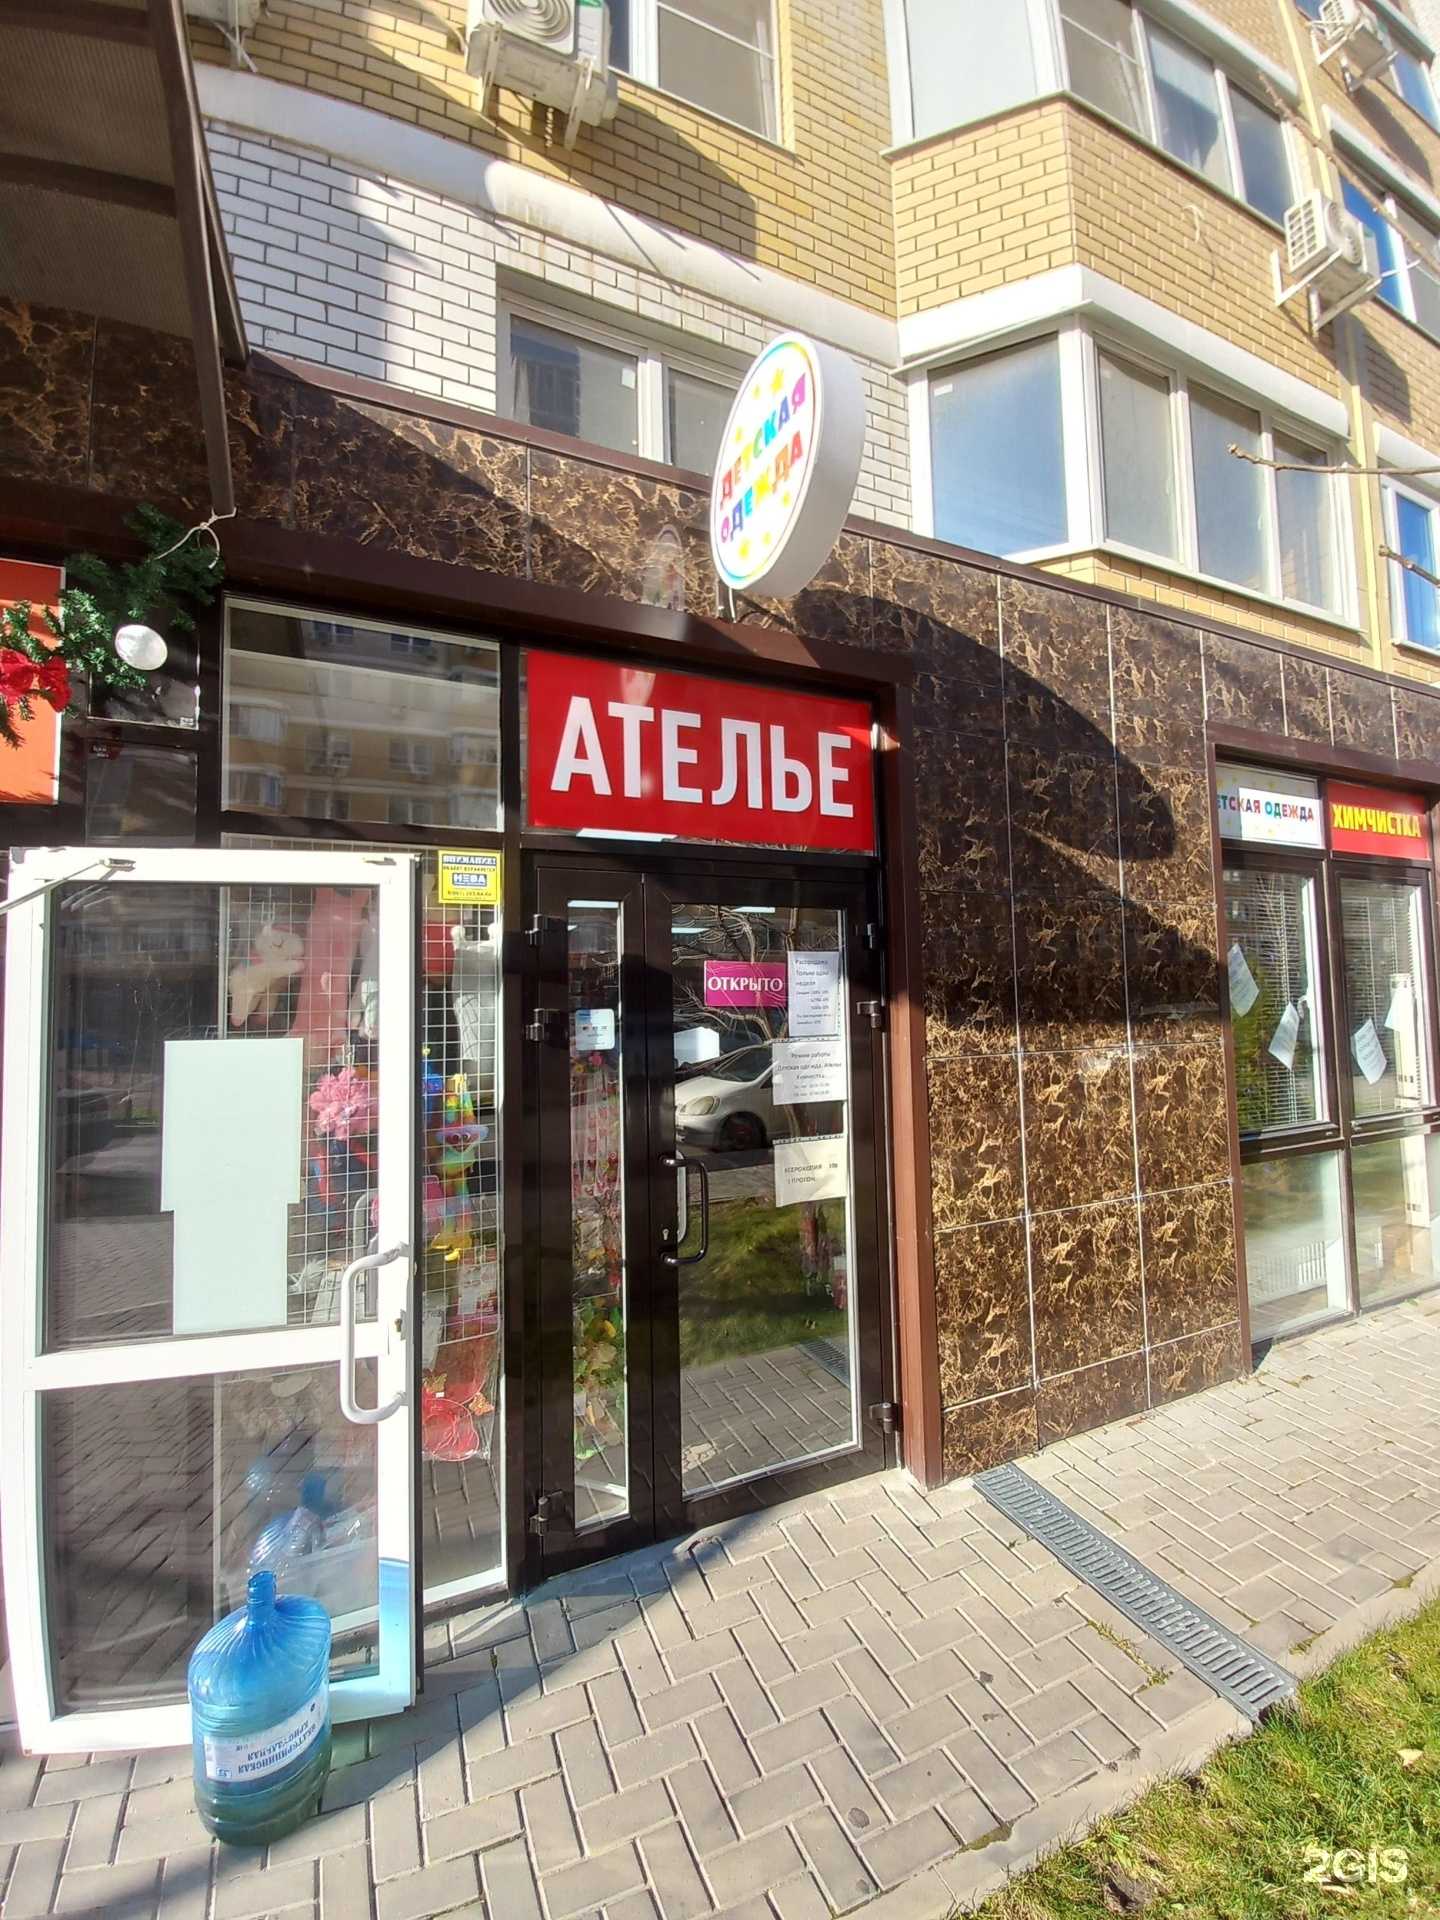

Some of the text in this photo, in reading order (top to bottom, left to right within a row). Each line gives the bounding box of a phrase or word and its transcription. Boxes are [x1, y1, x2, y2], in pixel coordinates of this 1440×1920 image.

[720, 372, 806, 511] ДЕТСКАЯ
[720, 431, 803, 544] ОДЕЖДА
[551, 695, 855, 819] АТЕЛЬЕ
[1217, 794, 1315, 822] ЕТСКАЯ ОДЕЖДА
[1331, 803, 1423, 838] ХИМЧИСТКА
[707, 975, 784, 992] ОТКРЫТО
